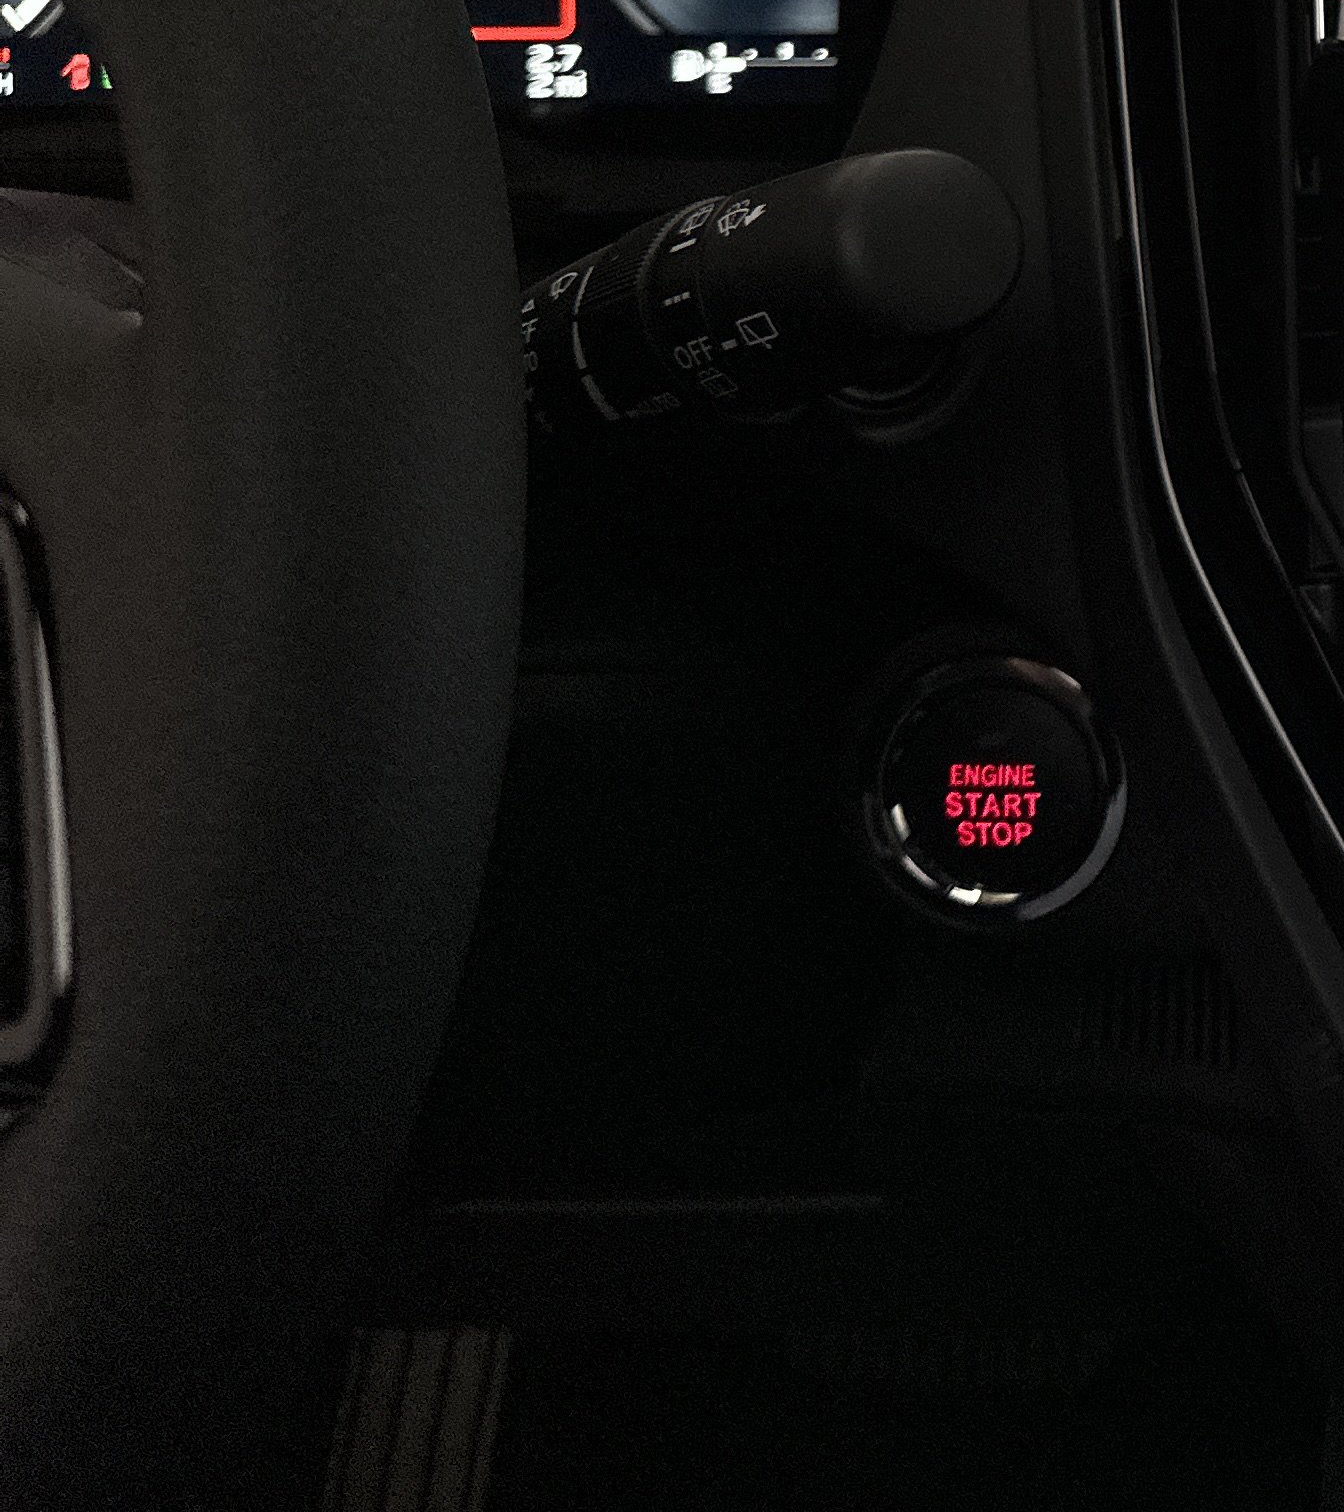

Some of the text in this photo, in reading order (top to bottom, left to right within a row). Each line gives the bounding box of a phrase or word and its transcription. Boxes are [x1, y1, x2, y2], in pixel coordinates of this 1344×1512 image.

[949, 763, 1036, 787] ENGINE
[945, 791, 1042, 818] START
[956, 820, 1033, 847] STOP
